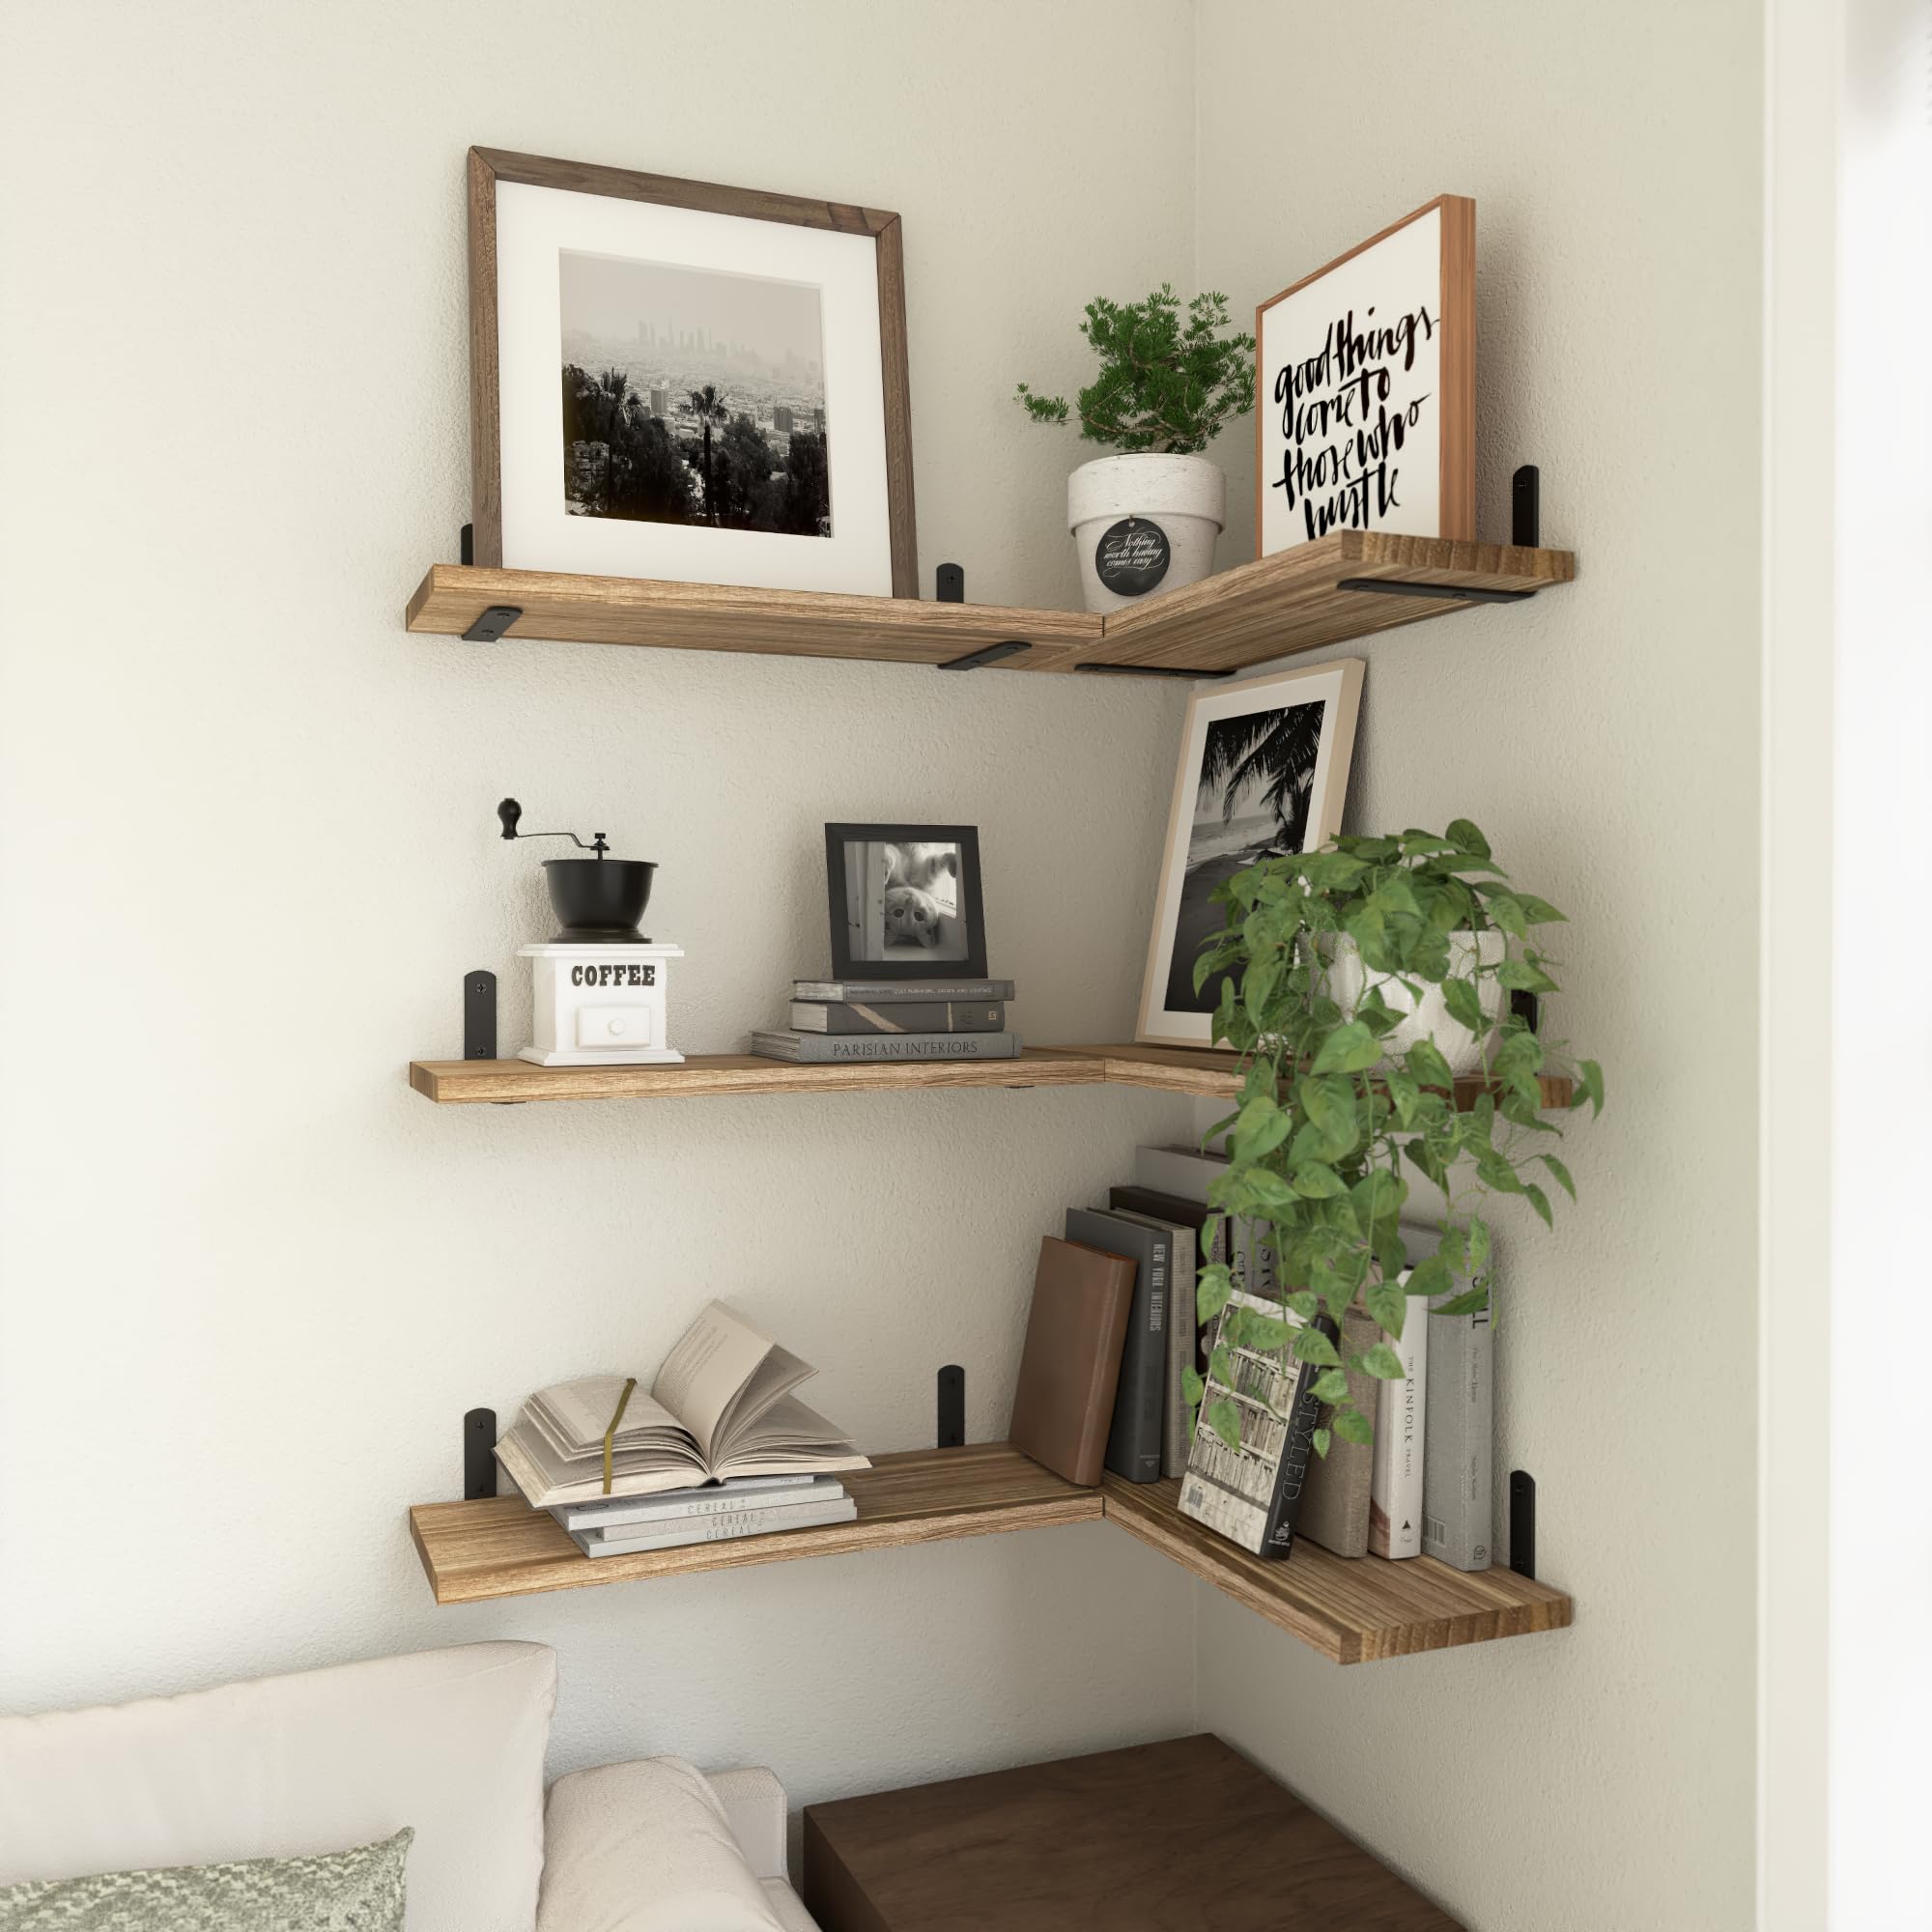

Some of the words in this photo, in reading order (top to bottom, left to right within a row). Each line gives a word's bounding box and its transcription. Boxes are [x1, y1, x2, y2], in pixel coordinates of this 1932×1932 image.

[1274, 322, 1333, 440] good
[1332, 305, 1440, 383] things
[1295, 387, 1356, 445] come
[1338, 366, 1391, 421] to
[1272, 438, 1353, 512] those
[1356, 392, 1433, 469] who
[1303, 461, 1401, 541] hustle
[571, 964, 656, 987] COFFEE
[833, 1041, 901, 1057] PARISIAN
[905, 1040, 979, 1055] INTERIORS
[1152, 1243, 1166, 1263] NEW
[1282, 1391, 1320, 1500] STYLED
[1405, 1378, 1415, 1444] KINFOLK
